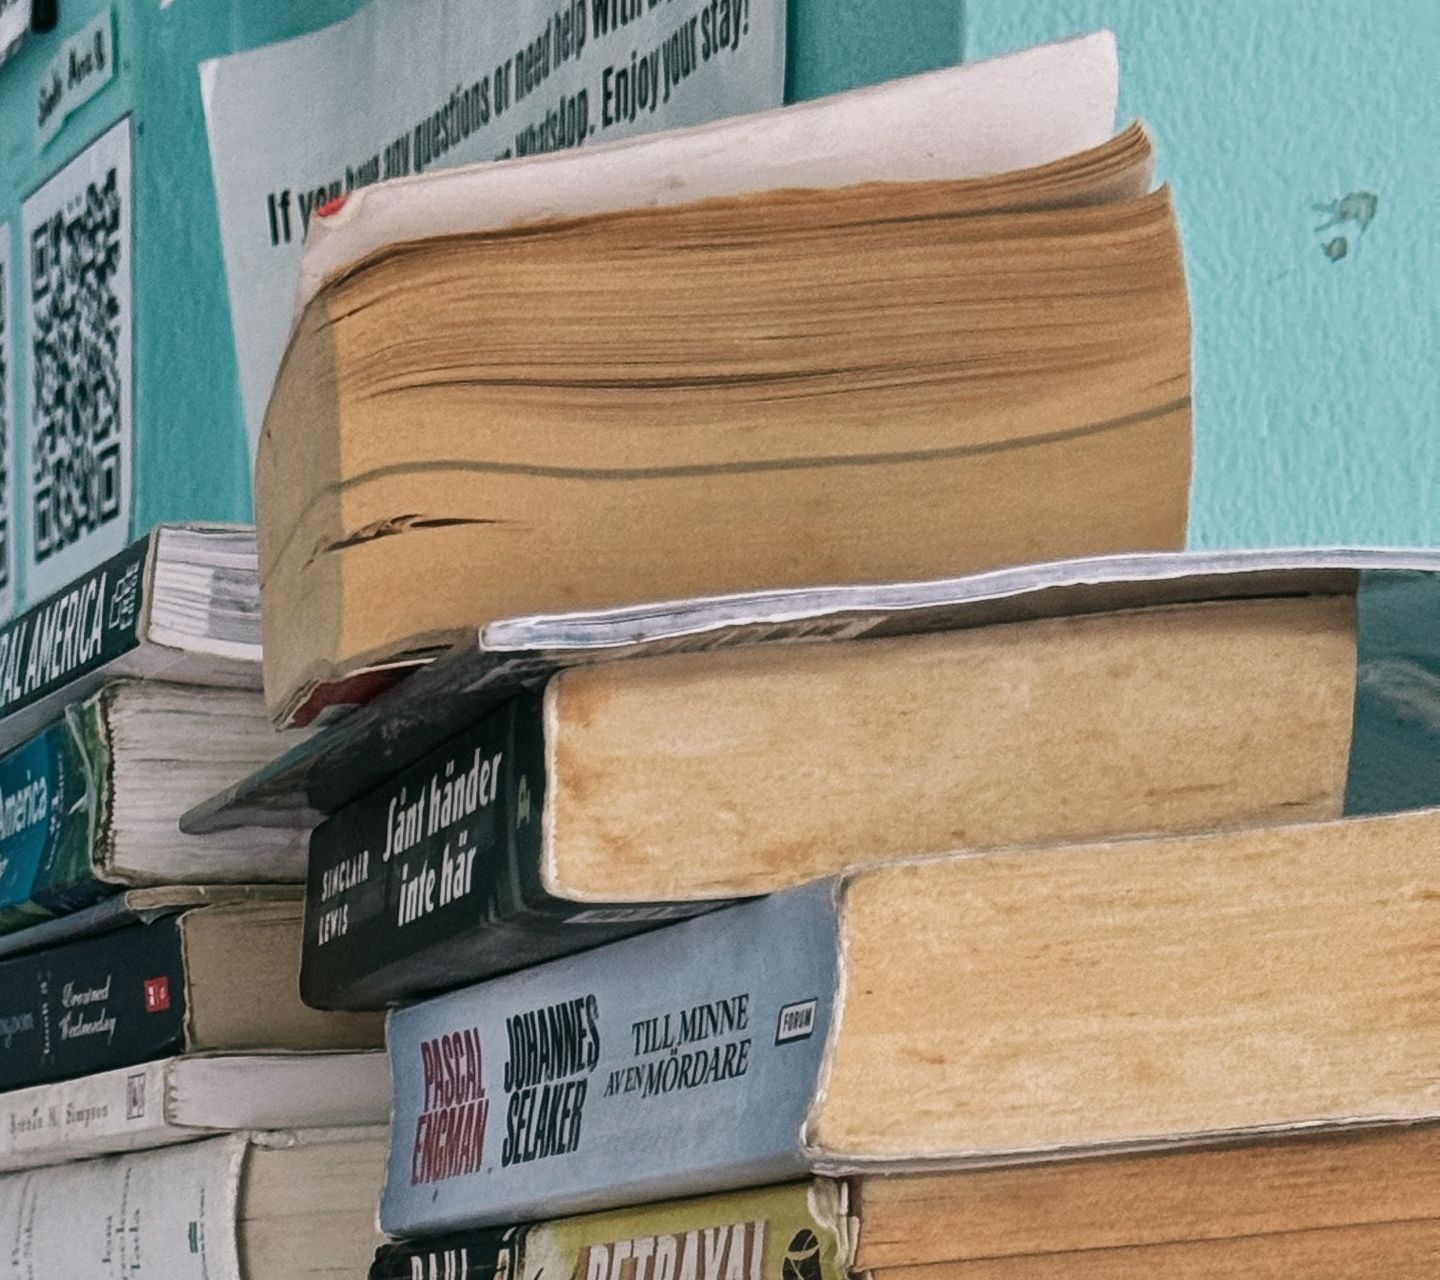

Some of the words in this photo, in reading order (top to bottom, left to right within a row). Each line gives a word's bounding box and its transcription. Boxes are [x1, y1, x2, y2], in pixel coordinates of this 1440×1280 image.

[602, 49, 659, 124] Enjoy
[663, 15, 697, 104] your
[701, 0, 750, 62] stay!
[268, 189, 291, 246] If
[414, 75, 490, 173] questions
[494, 59, 511, 117] or
[515, 18, 551, 103] need
[554, 0, 587, 70] help
[24, 572, 108, 695] AMERICA
[427, 747, 503, 837] händer
[321, 850, 369, 902] SINCLAIR
[397, 858, 436, 927] inte
[439, 830, 477, 908] här
[318, 903, 349, 946] LEWIS
[503, 993, 600, 1094] JOHANNES
[632, 1009, 678, 1057] TILL
[675, 993, 750, 1046] MINNE
[782, 1006, 812, 1033] FORUM
[420, 1027, 486, 1113] PASCAL
[603, 1071, 624, 1098] AV
[621, 1065, 646, 1095] EN
[641, 1038, 752, 1099] MÖRDARE
[411, 1098, 489, 1187] ENGMAN
[501, 1077, 588, 1169] SELAKER
